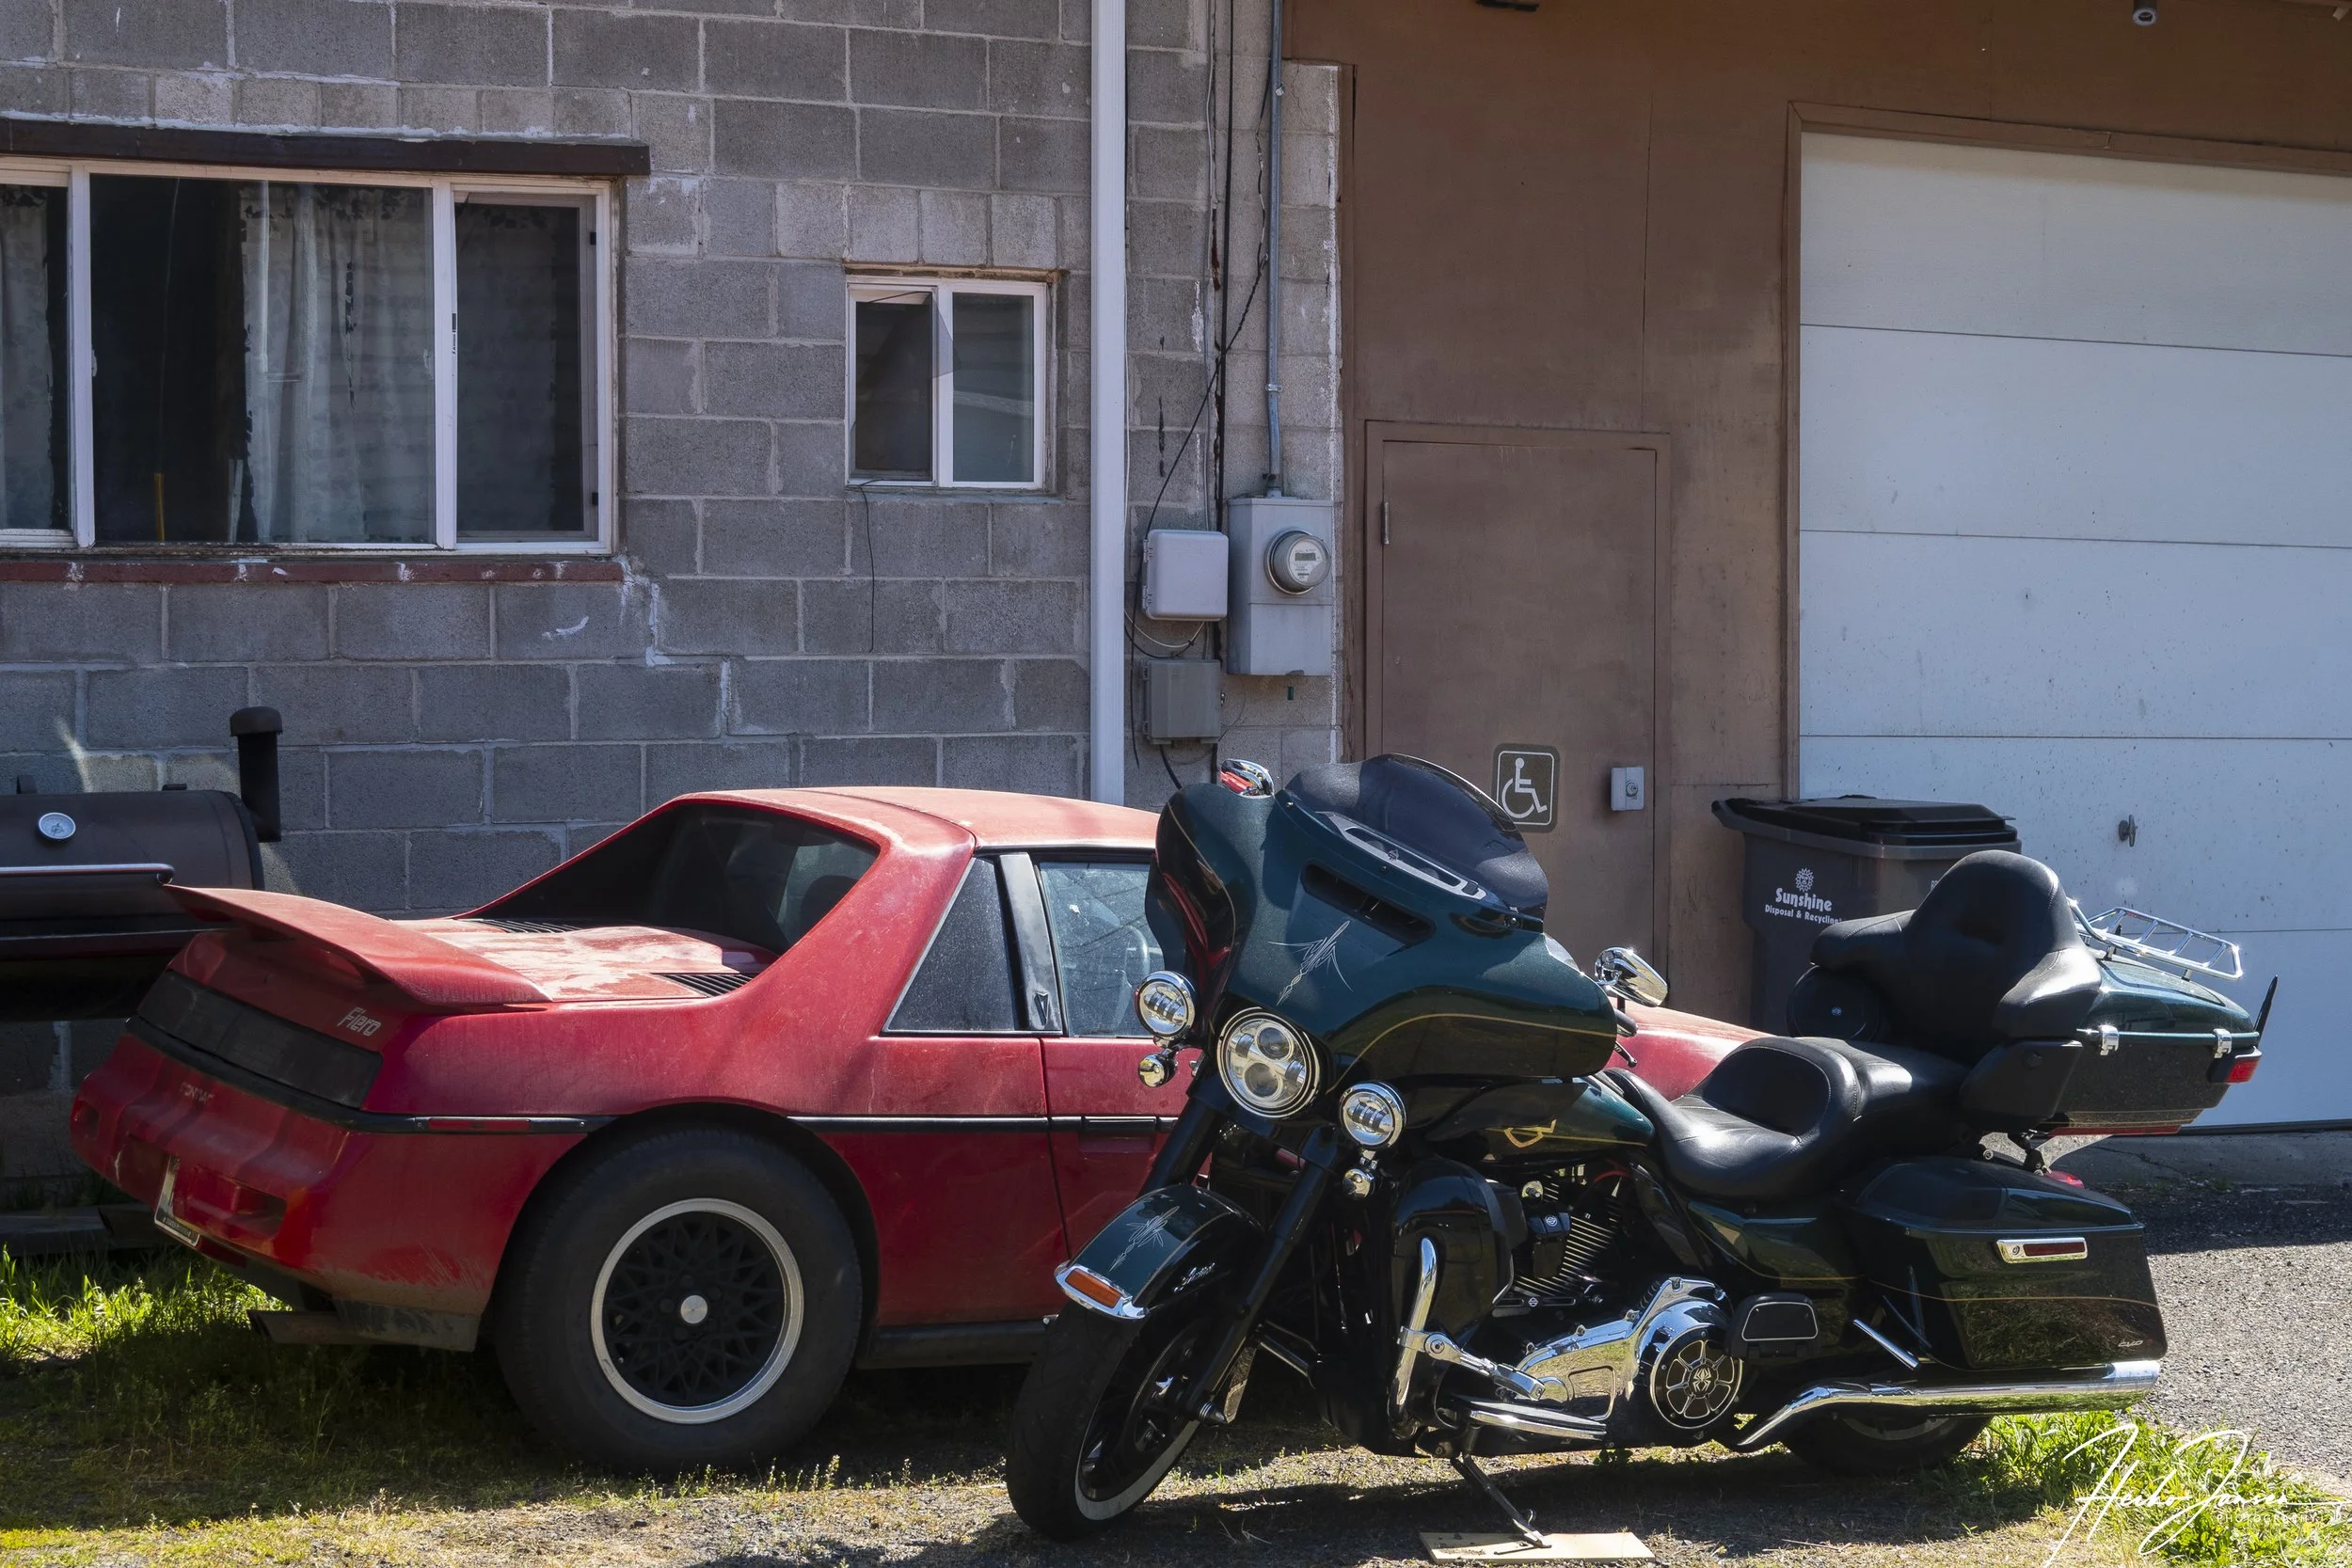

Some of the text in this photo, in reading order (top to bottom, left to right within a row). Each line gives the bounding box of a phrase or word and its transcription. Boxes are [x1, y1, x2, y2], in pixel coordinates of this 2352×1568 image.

[1765, 904, 1794, 918] Disposal
[1796, 910, 1802, 919] &
[1775, 887, 1833, 912] Sunshine
[336, 1006, 382, 1037] Fiero
